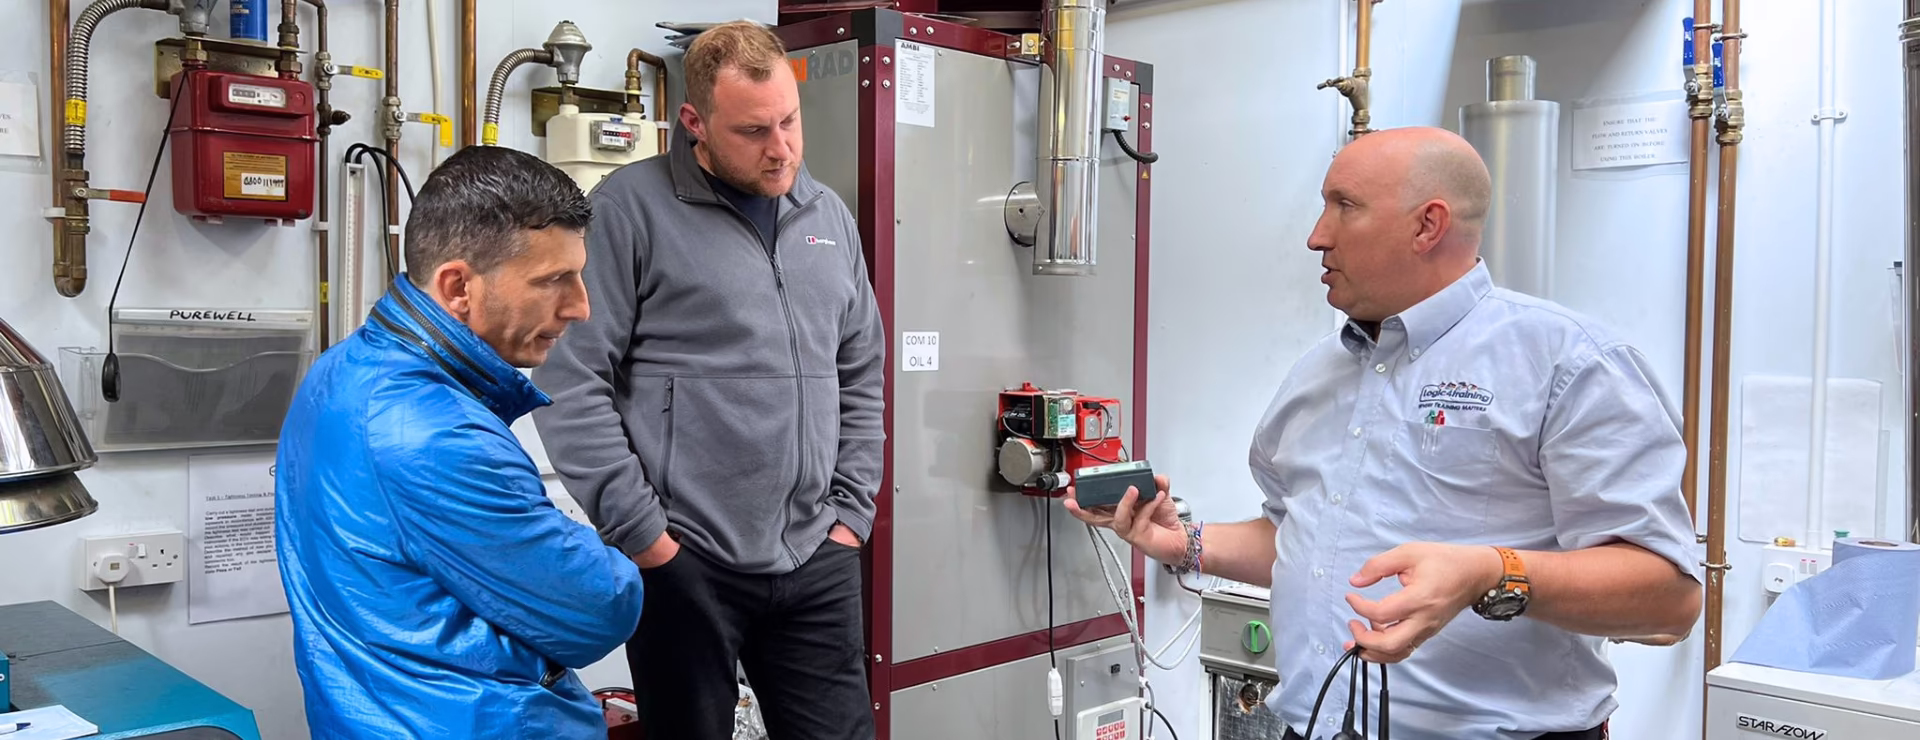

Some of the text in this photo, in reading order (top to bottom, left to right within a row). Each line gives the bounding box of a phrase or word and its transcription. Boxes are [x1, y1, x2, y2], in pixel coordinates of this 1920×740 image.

[1621, 129, 1644, 137] RETURN
[169, 309, 256, 322] PUREWELL
[905, 335, 937, 346] COM 10
[909, 355, 932, 367] OIL 4
[1739, 716, 1825, 740] STARFLOW
